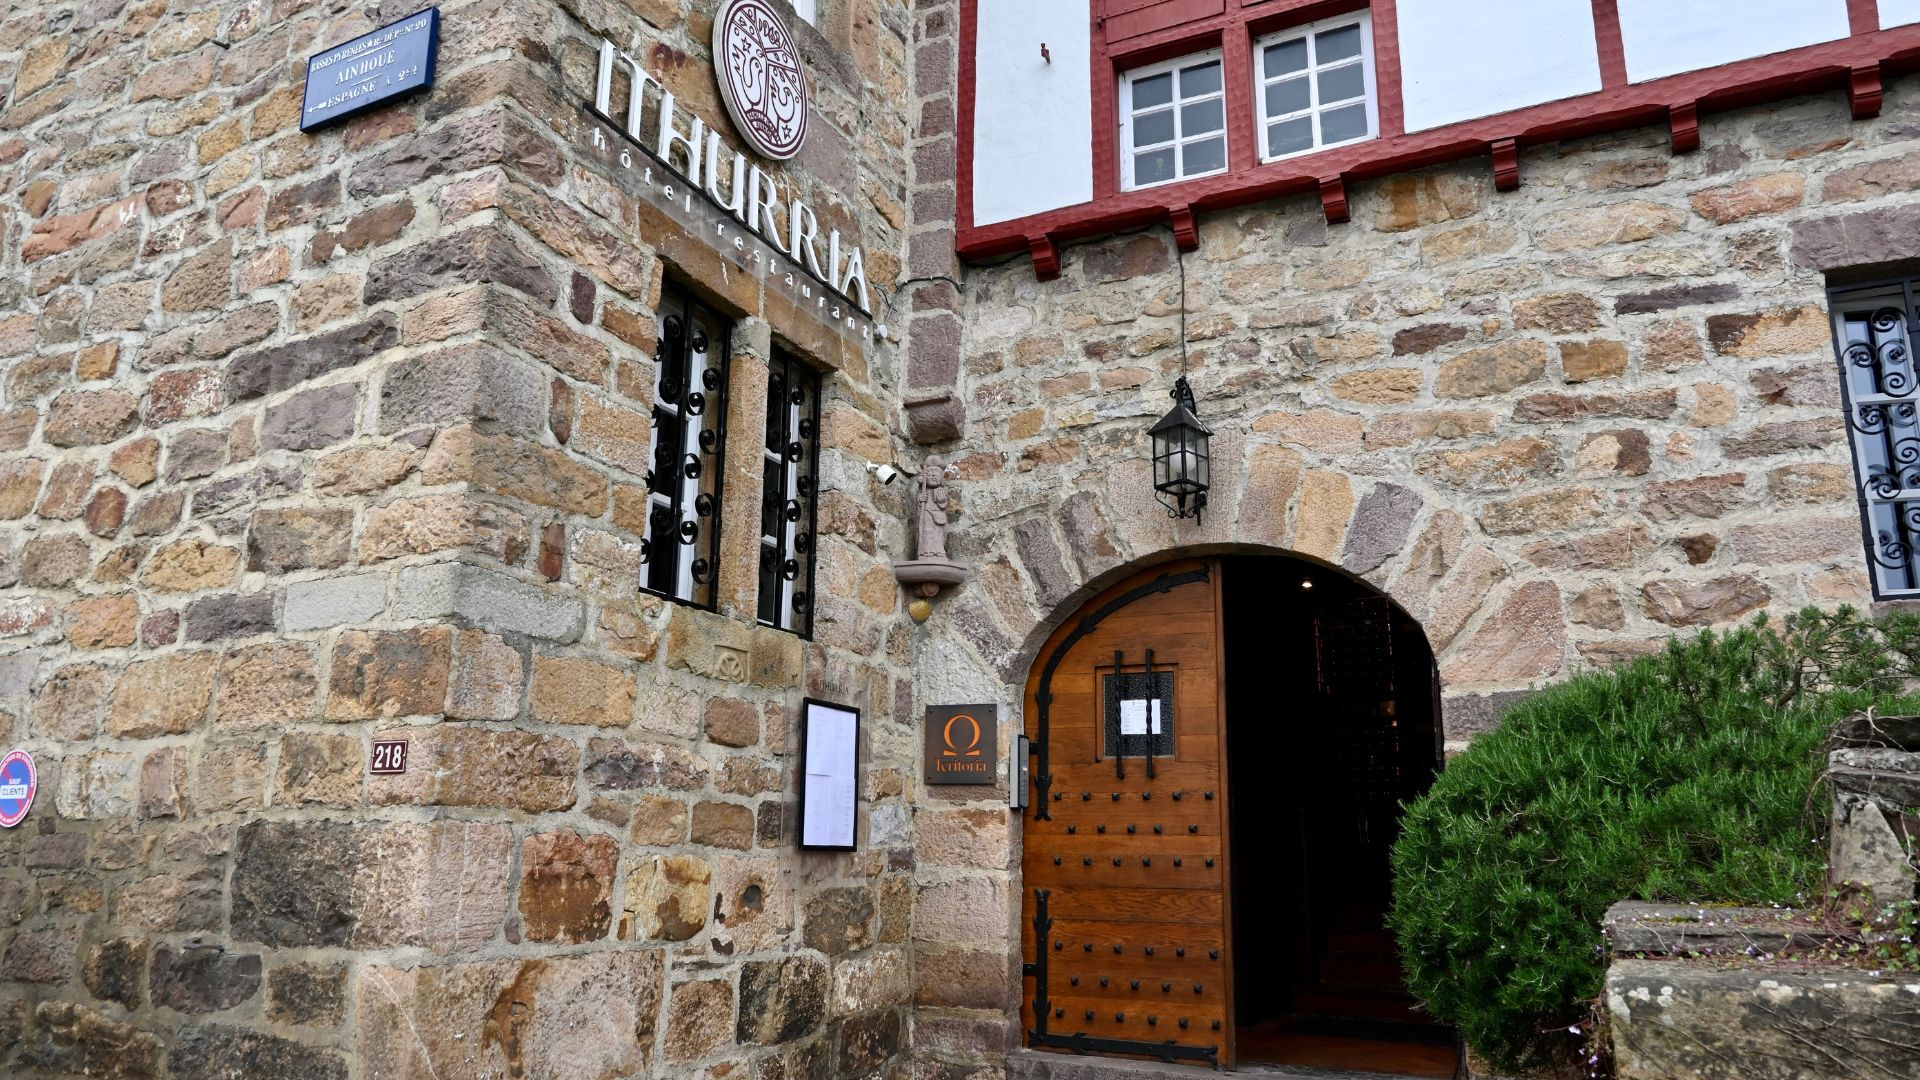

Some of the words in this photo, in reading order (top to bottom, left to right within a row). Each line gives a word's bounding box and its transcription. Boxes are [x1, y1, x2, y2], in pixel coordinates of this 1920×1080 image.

[311, 55, 333, 72] BASSES
[415, 18, 427, 31] 20
[335, 50, 395, 85] AINHOUE
[327, 81, 376, 108] ESPAGNE
[594, 37, 874, 314] ITHURRIA
[594, 126, 691, 213] hôtel
[717, 223, 871, 341] restaurant
[374, 745, 402, 768] 218
[2, 788, 25, 796] CLIENTS
